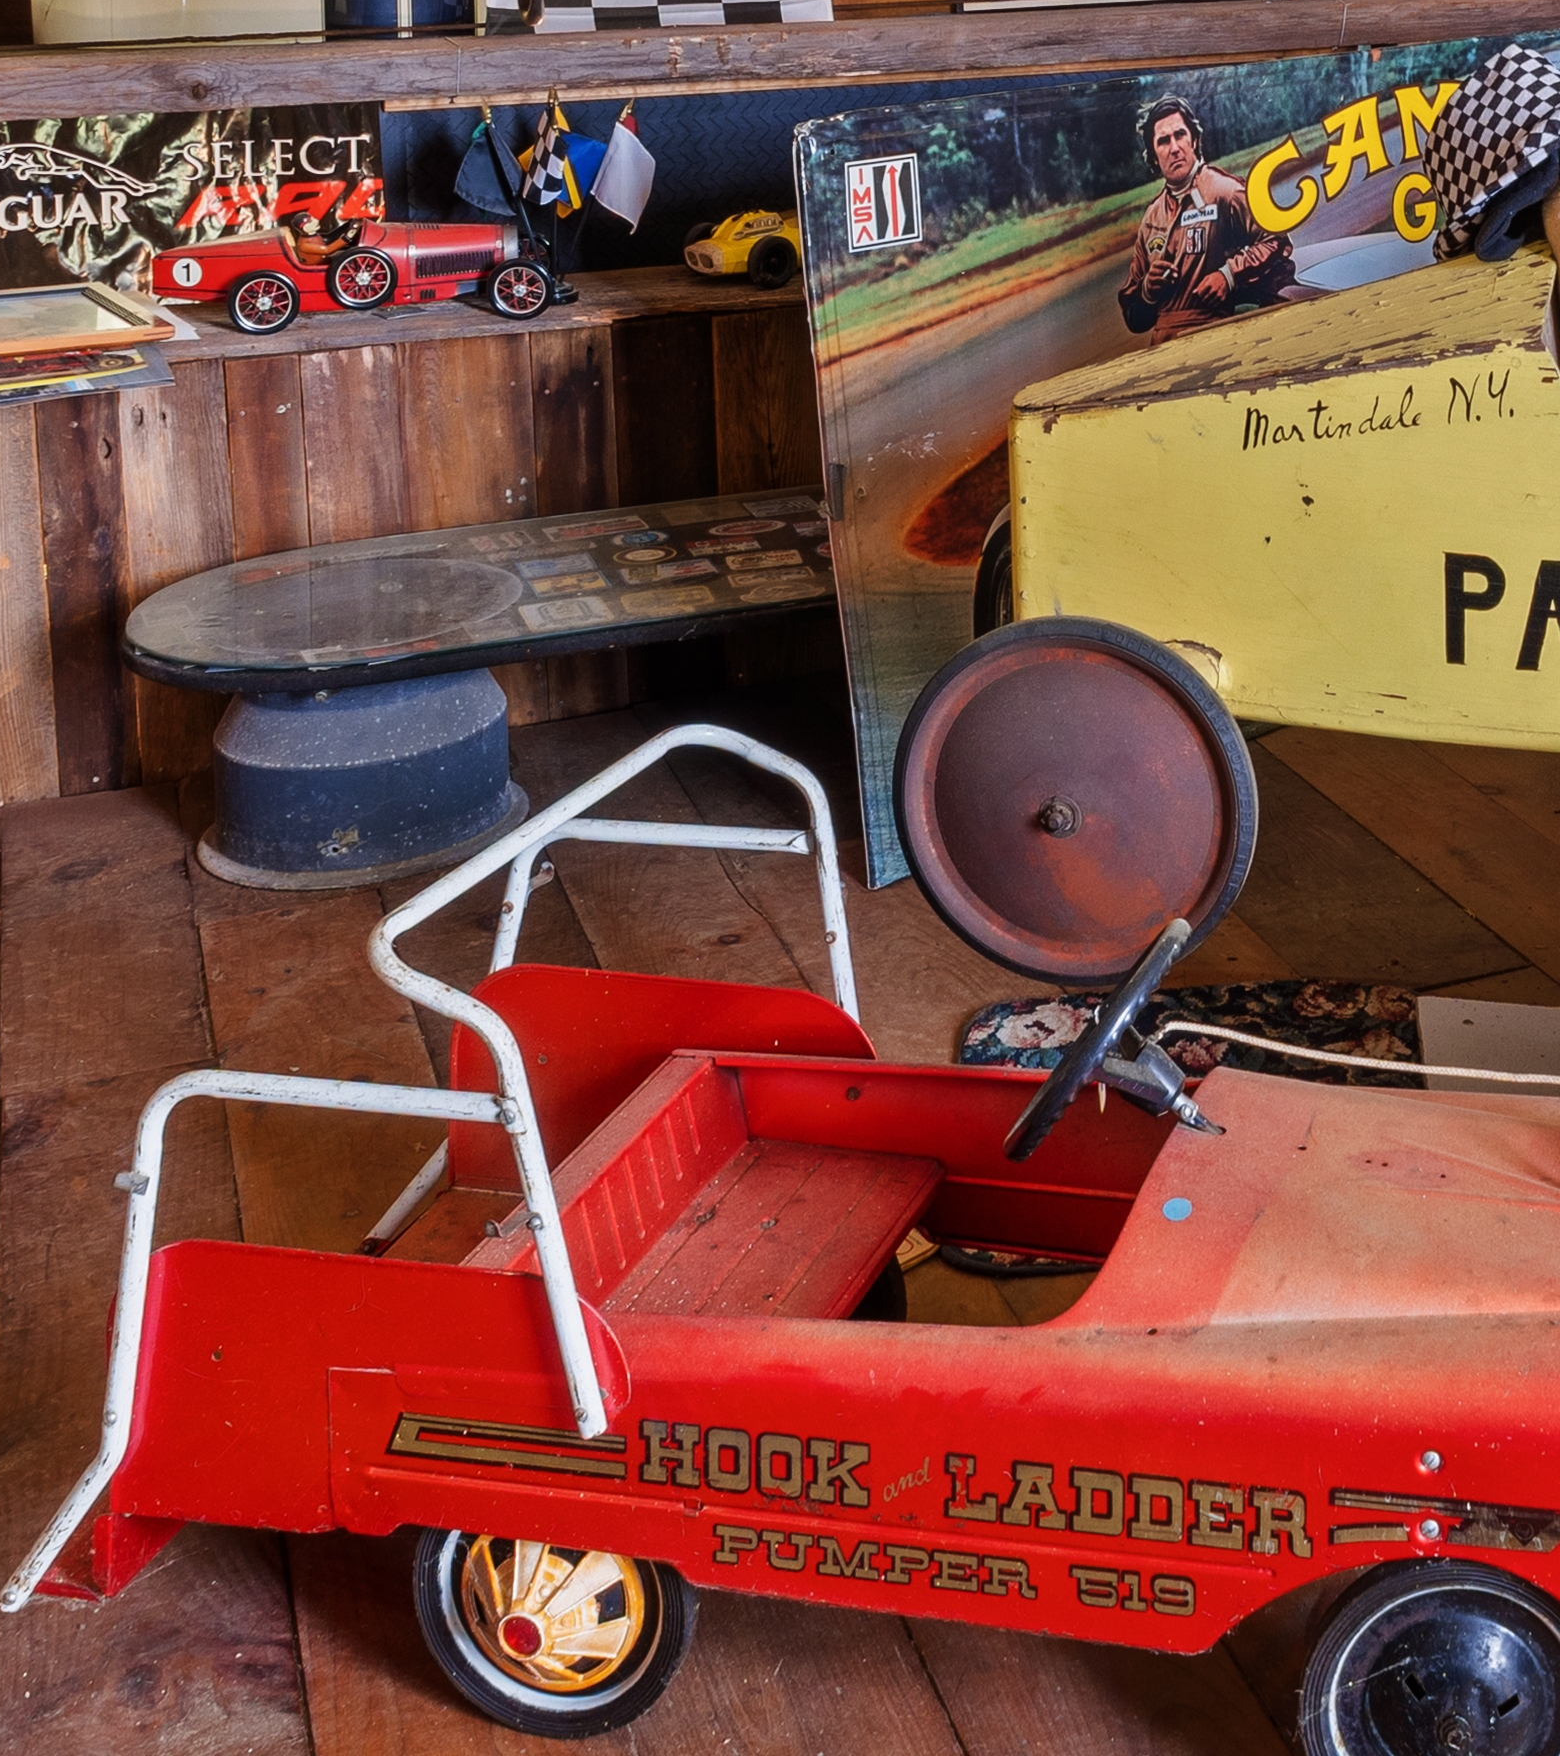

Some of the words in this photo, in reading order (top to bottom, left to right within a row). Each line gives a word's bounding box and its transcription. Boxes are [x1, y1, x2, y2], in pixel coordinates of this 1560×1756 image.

[181, 135, 371, 182] SELECT
[1244, 79, 1466, 234] CAM
[1391, 172, 1438, 244] G
[179, 263, 192, 284] 1
[1243, 384, 1422, 452] Martindale
[1447, 367, 1516, 424] N.Y.
[639, 1419, 872, 1509] HOOK
[881, 1458, 933, 1504] and
[944, 1452, 1314, 1558] LADDER
[712, 1523, 1040, 1601] PUMPER
[1069, 1565, 1197, 1616] 519
